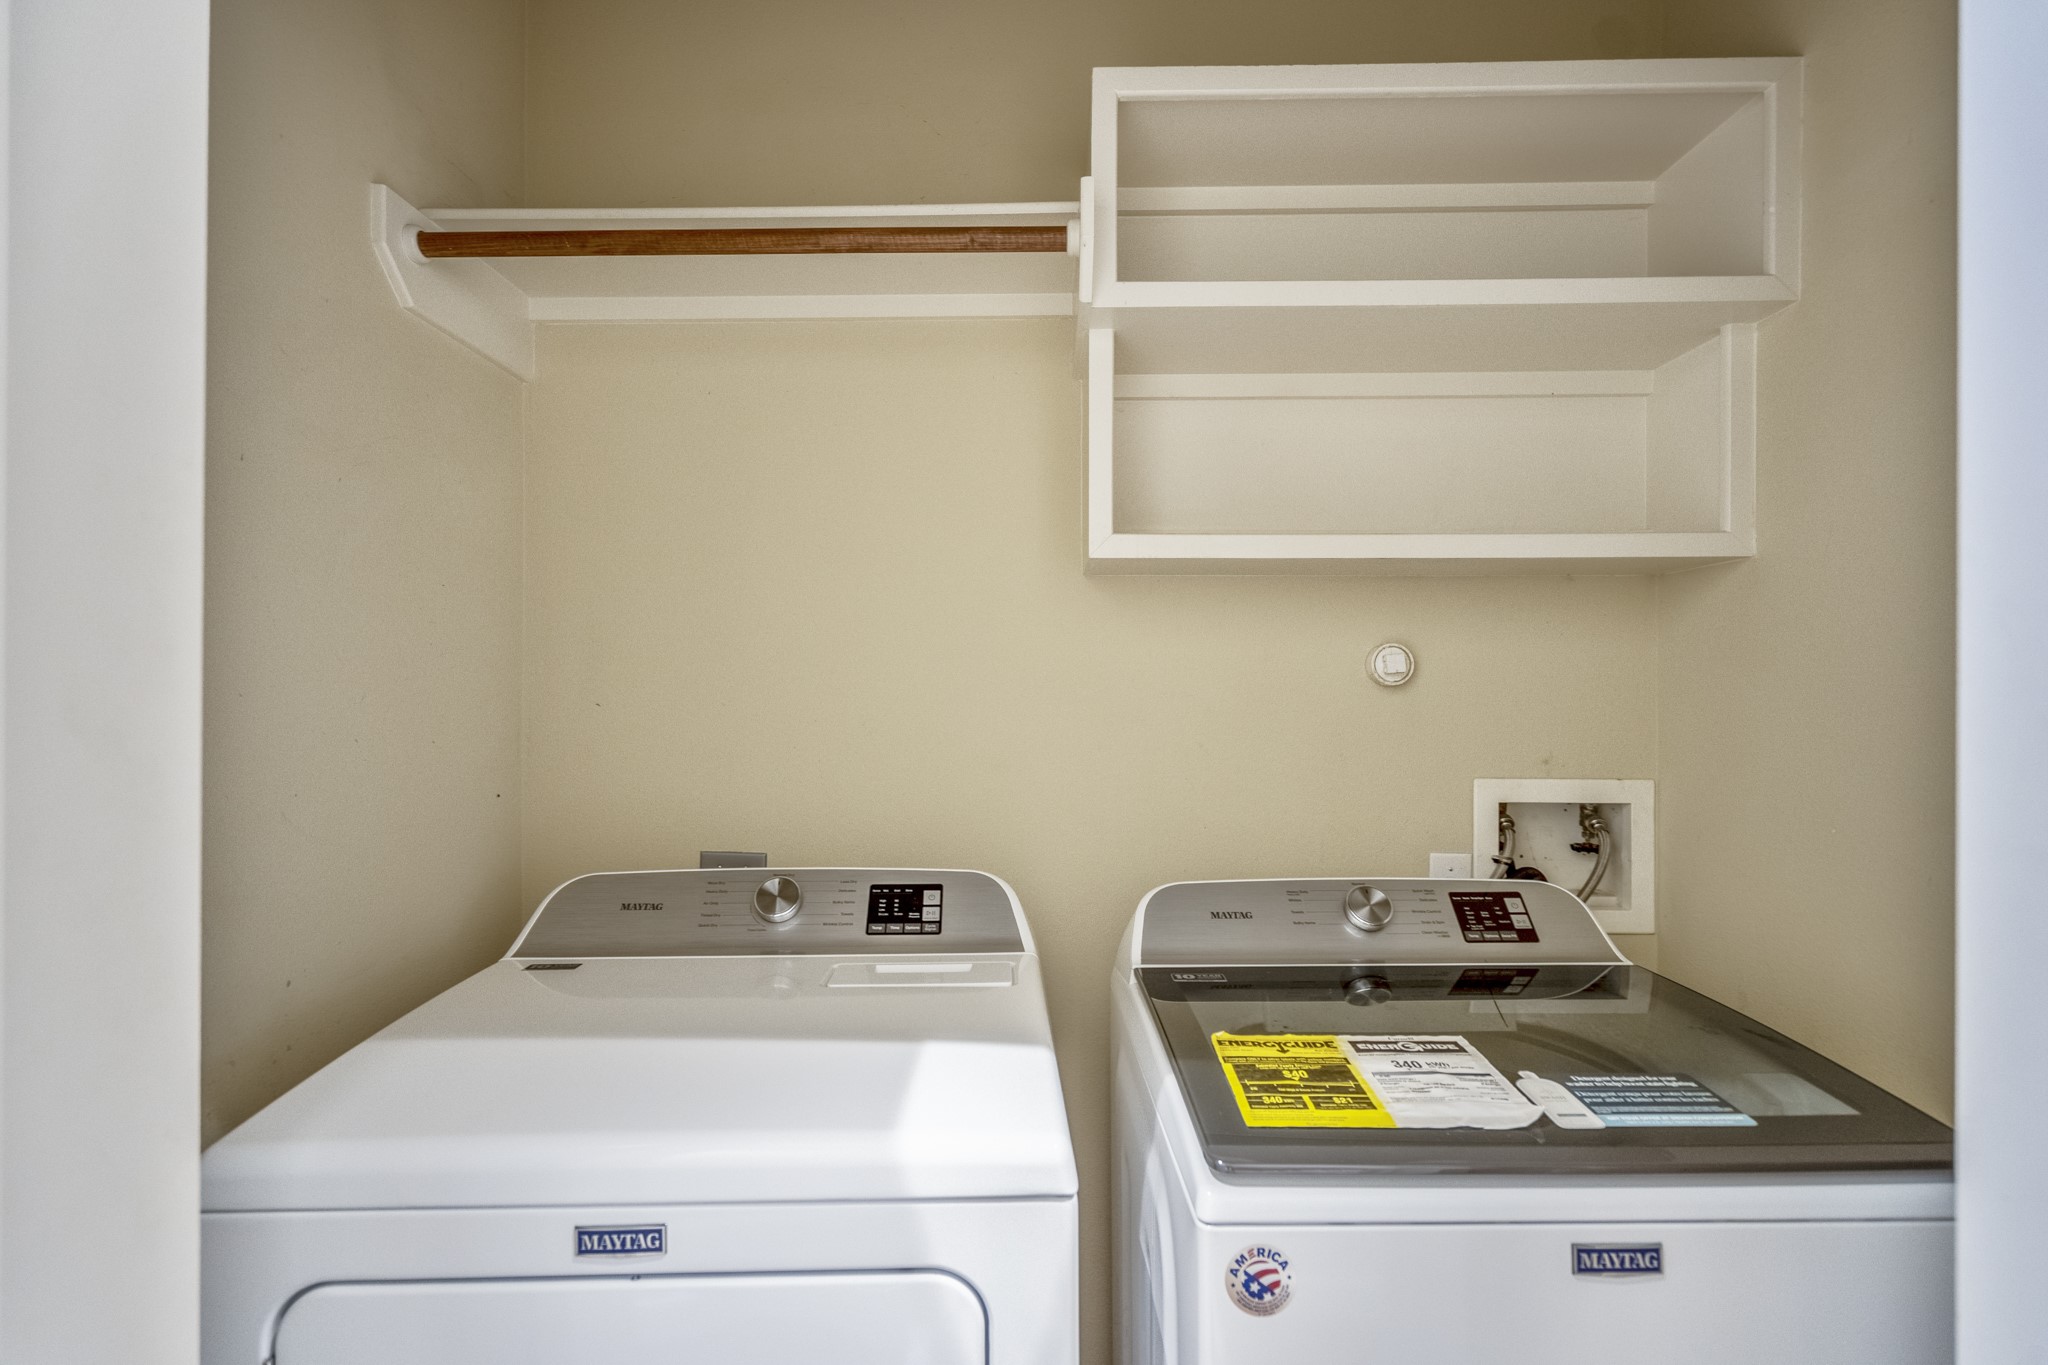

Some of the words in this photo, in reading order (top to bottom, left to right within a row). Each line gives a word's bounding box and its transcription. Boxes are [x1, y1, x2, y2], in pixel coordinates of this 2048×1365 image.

[620, 902, 663, 911] MAYTAG
[1210, 911, 1253, 919] MAYTAG
[1216, 1039, 1338, 1050] ENERGYGUIDE
[1391, 1060, 1423, 1069] 340
[1282, 1070, 1309, 1080] $40
[1262, 1096, 1283, 1104] 340
[581, 1232, 660, 1251] MAYTAG
[1229, 1247, 1289, 1279] AMERICA
[1579, 1251, 1659, 1270] MAYTAG
